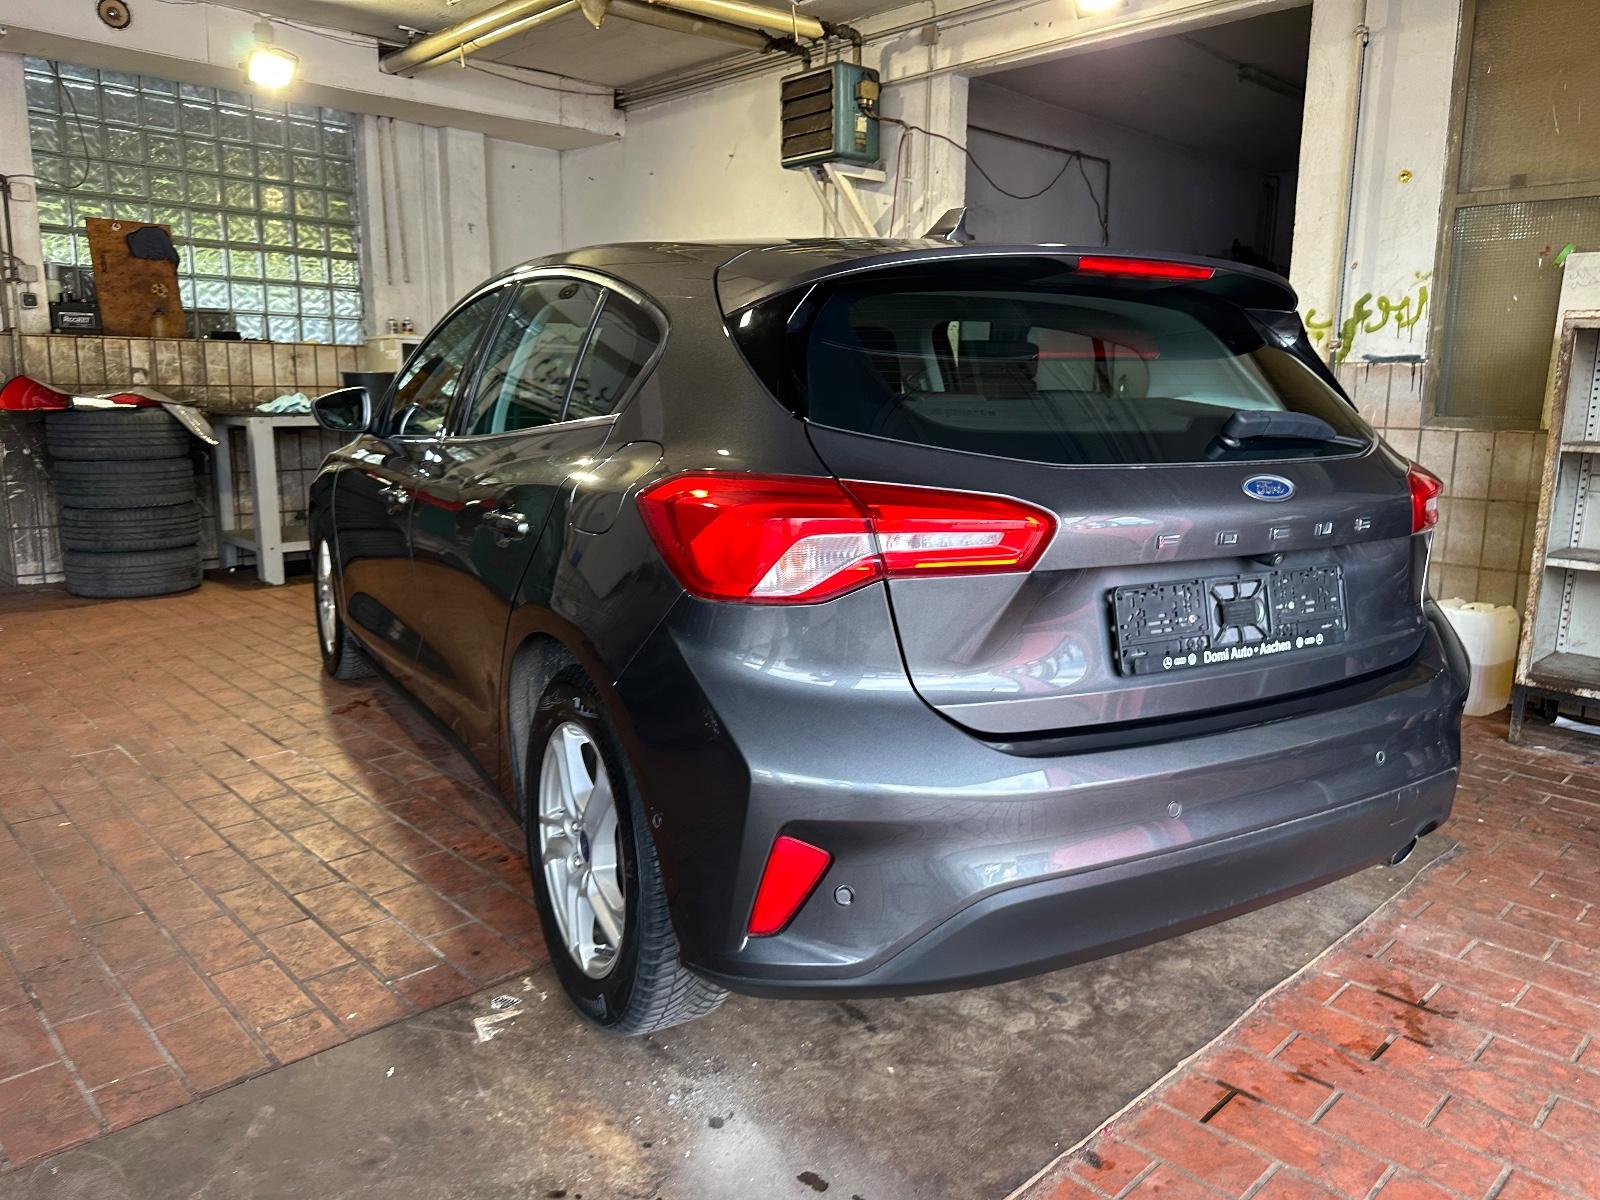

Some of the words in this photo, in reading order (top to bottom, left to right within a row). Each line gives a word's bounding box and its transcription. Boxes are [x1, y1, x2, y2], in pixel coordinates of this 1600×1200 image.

[1203, 647, 1230, 664] Domi
[1230, 645, 1253, 660] Auto
[1259, 639, 1292, 656] Aachen
